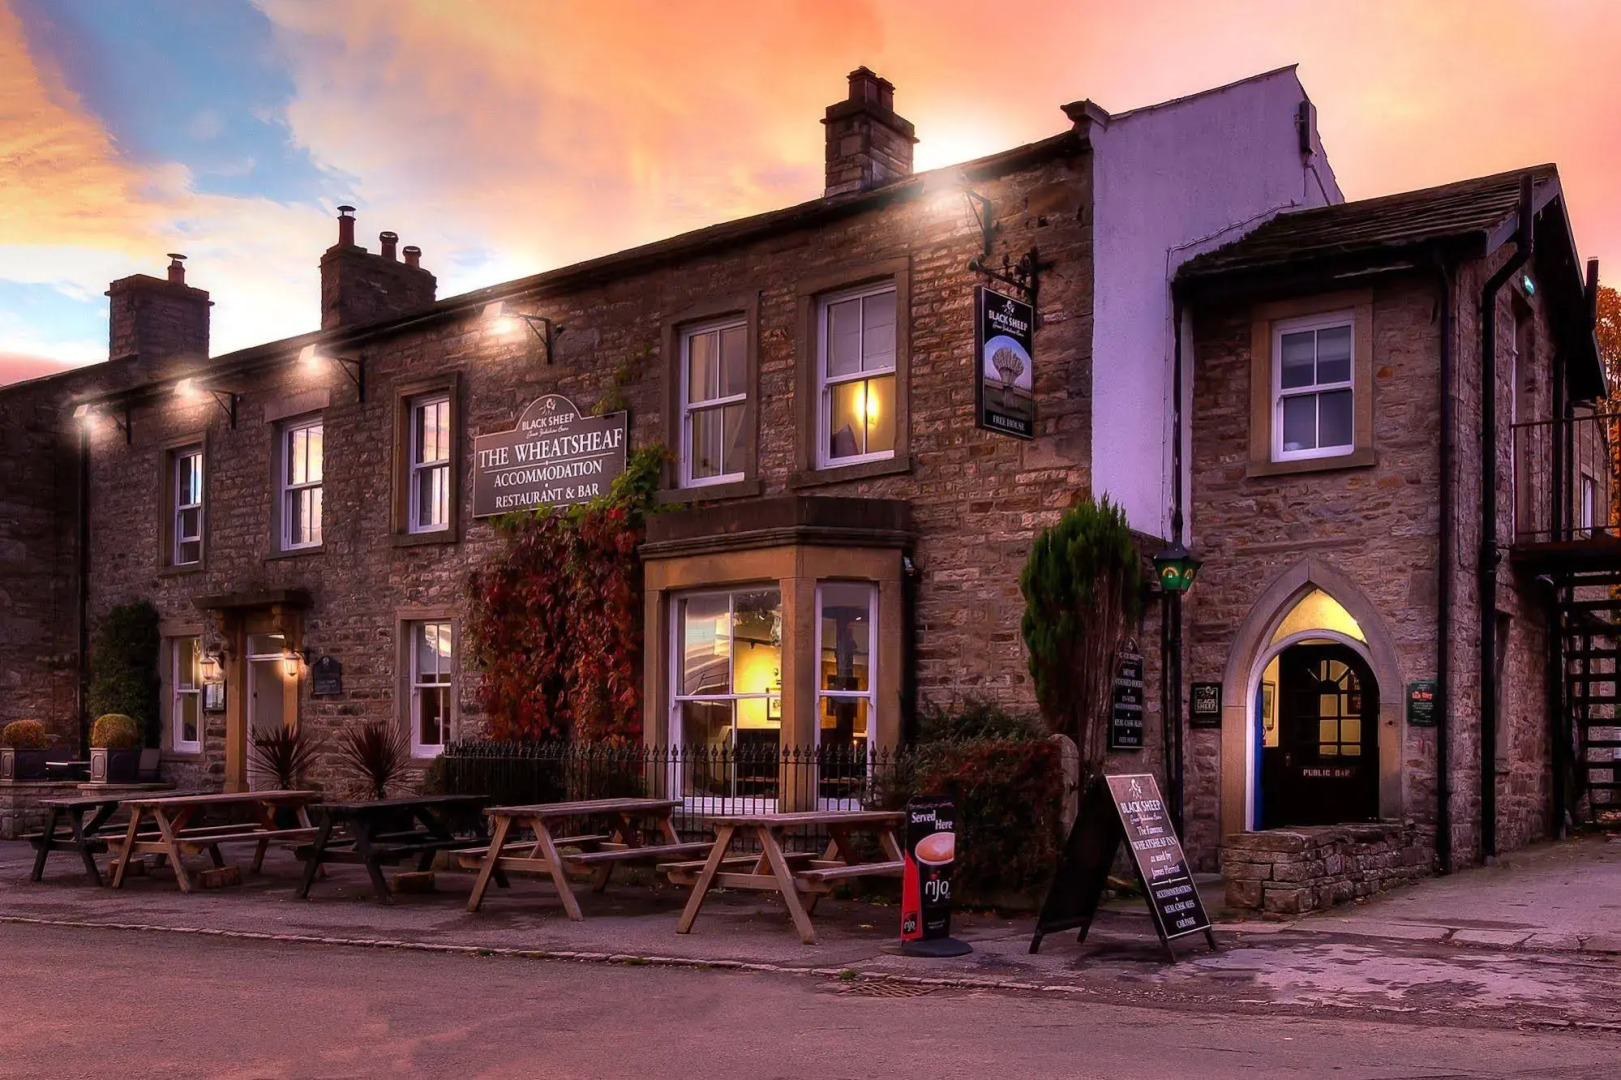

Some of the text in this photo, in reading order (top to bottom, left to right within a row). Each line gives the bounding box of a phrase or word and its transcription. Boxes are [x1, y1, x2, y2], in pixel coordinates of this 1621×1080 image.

[988, 309, 1028, 331] BLACK SHEEP
[521, 413, 575, 431] BLACK SHEEP
[992, 414, 1025, 431] FREE HOUSE
[478, 428, 623, 468] THE WHEATSHEAF
[494, 459, 603, 488] ACCOMMODATION
[495, 483, 600, 508] RESTAURANT & BAR
[1303, 769, 1350, 777] PUBLIC BAR
[1120, 799, 1161, 814] BLACK SHEEP
[911, 809, 936, 823] Served
[935, 819, 953, 830] Here
[1136, 826, 1147, 837] The
[1132, 838, 1167, 851] WHEATSHEAF
[925, 873, 949, 902] rijo
[1176, 919, 1186, 929] CAR
